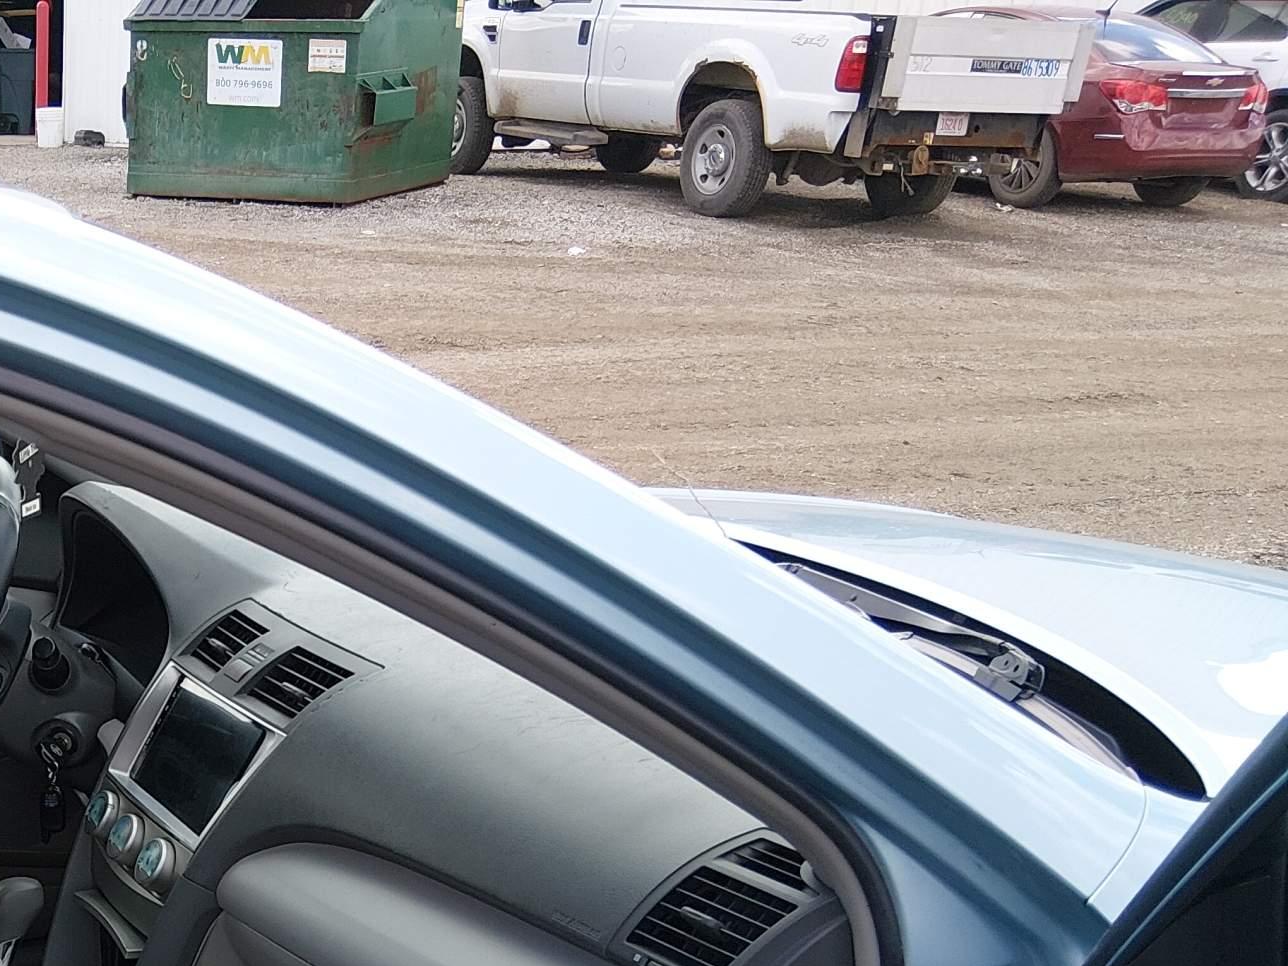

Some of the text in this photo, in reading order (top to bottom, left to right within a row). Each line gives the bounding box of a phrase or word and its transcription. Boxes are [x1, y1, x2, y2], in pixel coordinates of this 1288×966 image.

[791, 33, 829, 48] 4x4
[215, 43, 272, 64] WM
[972, 60, 1022, 71] TOMMY GATE
